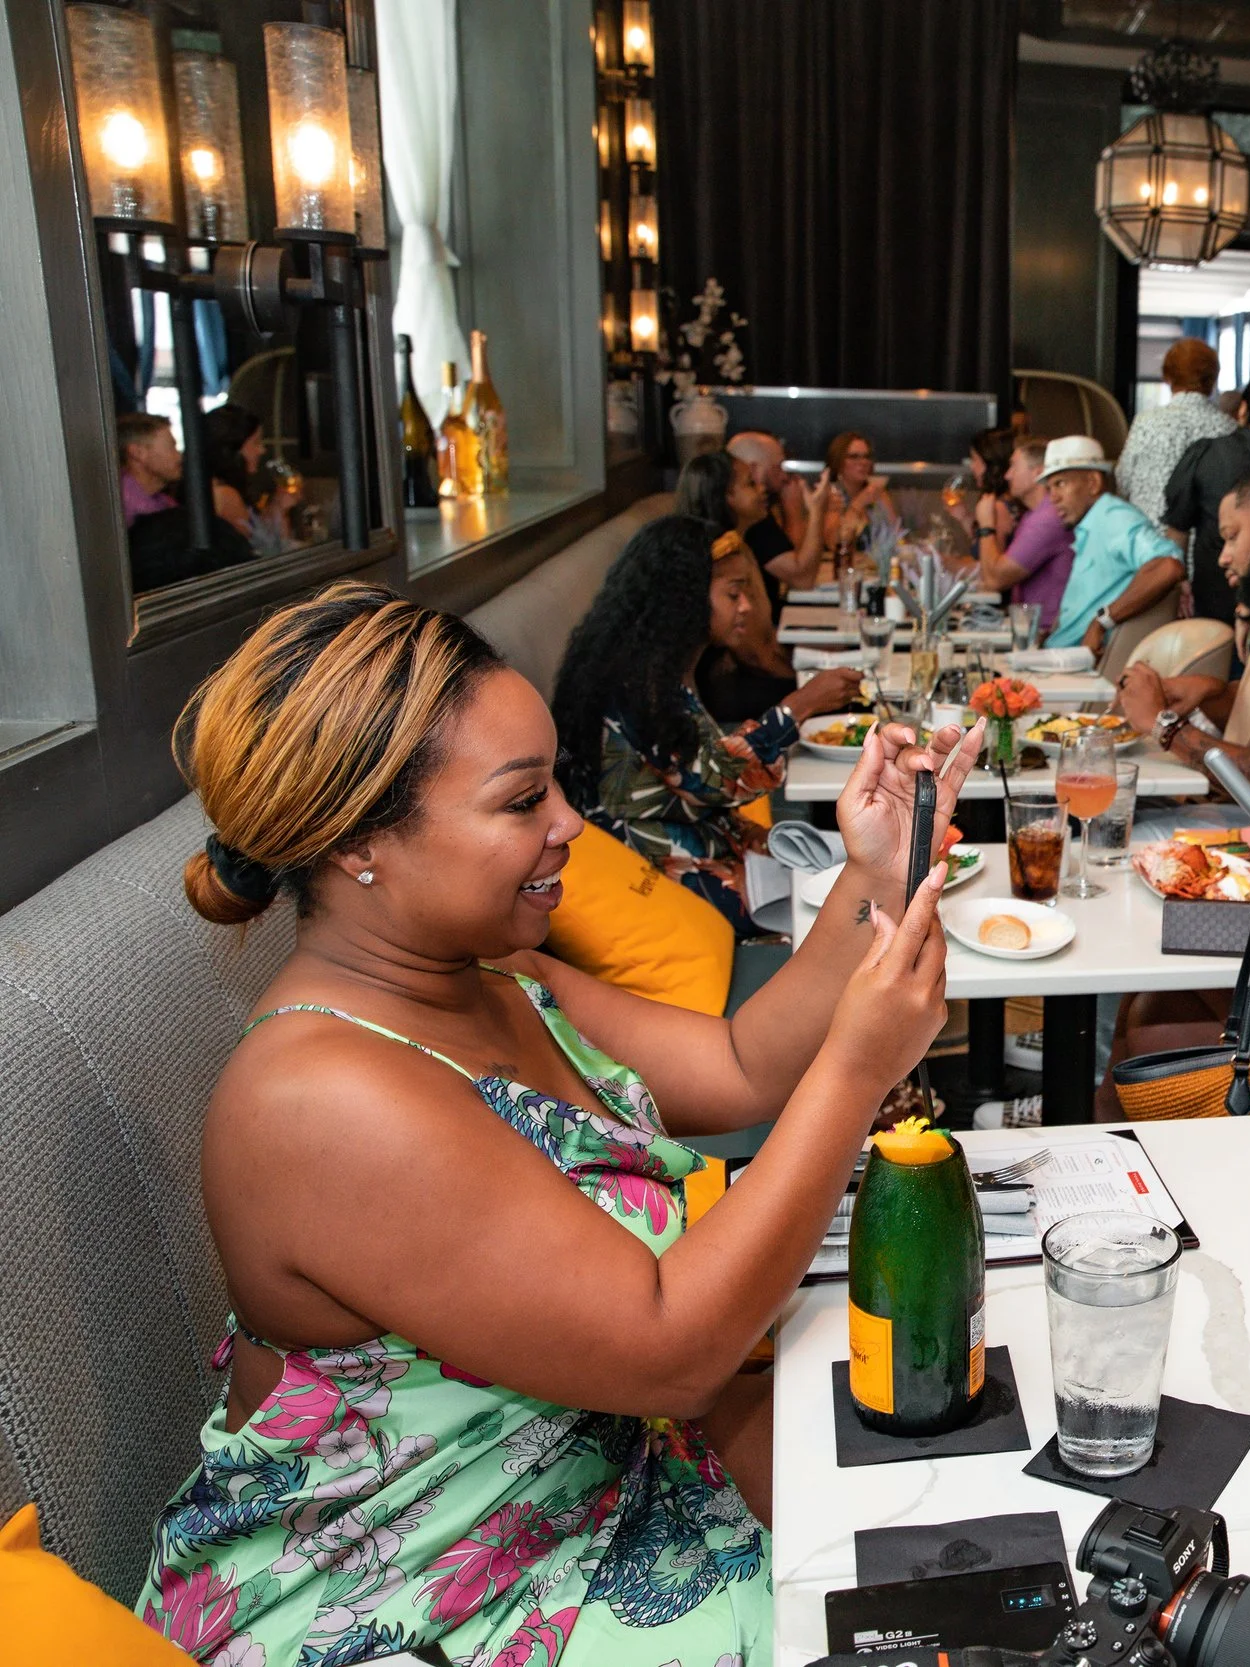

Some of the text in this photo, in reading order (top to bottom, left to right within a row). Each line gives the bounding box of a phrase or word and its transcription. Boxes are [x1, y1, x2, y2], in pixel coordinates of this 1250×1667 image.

[1172, 1539, 1196, 1575] SONY
[875, 1643, 898, 1651] VIDEO
[900, 1640, 921, 1648] LIGHT
